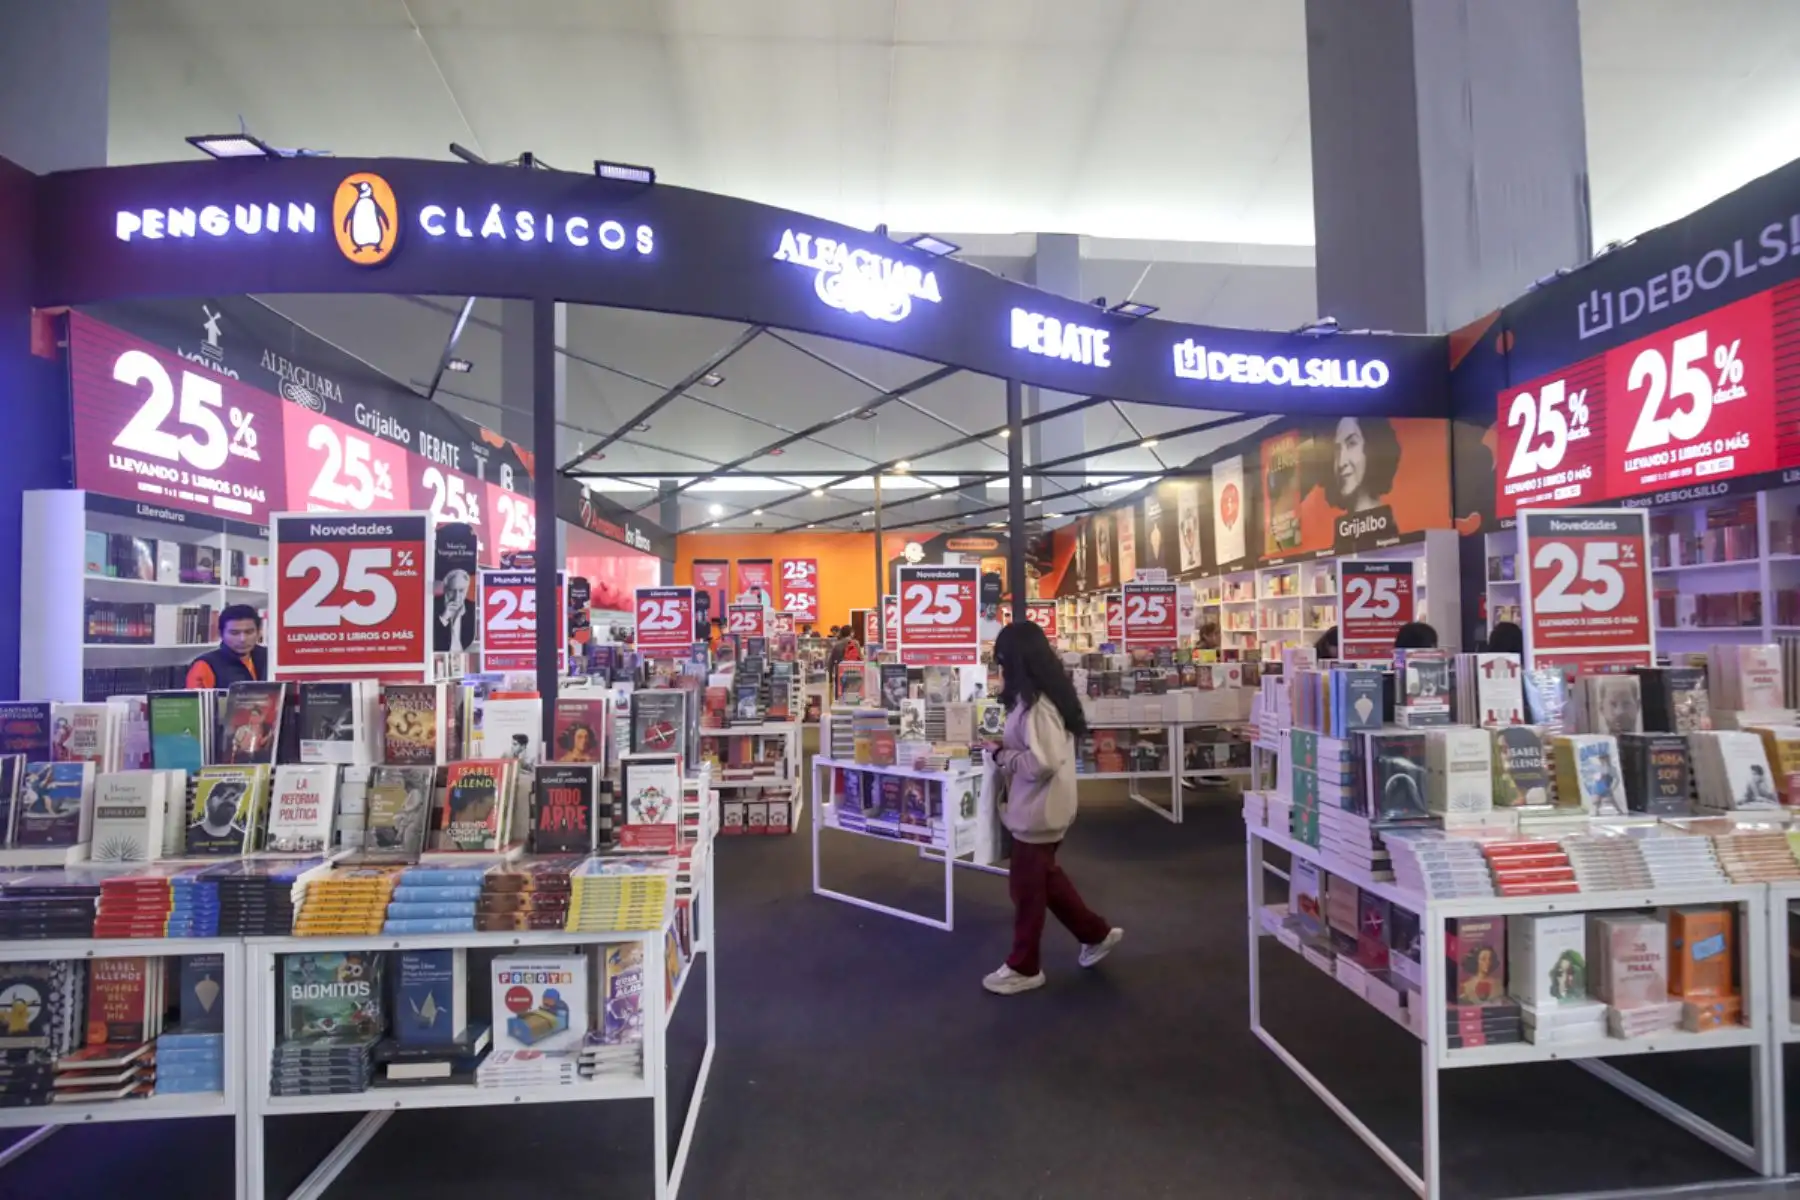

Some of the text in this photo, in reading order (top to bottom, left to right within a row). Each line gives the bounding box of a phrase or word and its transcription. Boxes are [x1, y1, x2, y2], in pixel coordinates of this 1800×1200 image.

[115, 202, 655, 254] PENGUIN CLÁSICOS
[773, 228, 942, 303] ALFAGUARA
[1009, 307, 1112, 368] DEBATE
[260, 348, 345, 404] ALFAGUARA
[1208, 349, 1390, 389] DEBOLSILLO
[1625, 330, 1744, 453] 25%
[112, 350, 257, 470] 25%
[355, 403, 411, 444] Grijalbo
[1506, 379, 1589, 479] 25%
[419, 430, 460, 470] DEBATE
[1624, 450, 1669, 472] LLEVANDO
[1678, 441, 1712, 461] LIBROS
[1714, 440, 1723, 454] O
[1725, 431, 1750, 451] MÁS
[109, 454, 179, 483] LLEVANDO
[192, 473, 230, 495] LIBROS
[232, 484, 241, 497] O
[243, 484, 266, 503] MÁS
[308, 423, 391, 510] 25%
[1574, 464, 1592, 480] MÁS
[1620, 482, 1728, 508] Libros DEBOLSILLO
[137, 503, 186, 522] Literatura
[1550, 519, 1617, 531] Novedades
[310, 523, 393, 538] Novedades
[1338, 515, 1387, 538] Grijalbo
[283, 547, 414, 628] 25%
[916, 571, 960, 579] Novedades
[1534, 542, 1639, 613] 25%
[904, 584, 971, 625] 25%
[1127, 595, 1173, 625] 25%
[1345, 577, 1408, 619] 25%
[639, 599, 688, 631] 25%
[287, 629, 414, 642] LLEVANDO 3 LIBROS O MÁS
[296, 778, 308, 790] LA
[458, 767, 494, 776] ISABEL
[280, 793, 320, 804] REFORMA
[548, 788, 581, 805] TODO
[1660, 784, 1678, 795] YO
[279, 806, 318, 821] POLÍTICA
[540, 805, 588, 831] ARDE
[95, 972, 141, 981] ALLENDE
[100, 961, 135, 972] ISABEL
[96, 984, 140, 992] MUJERES
[107, 993, 125, 1001] DEL
[291, 981, 370, 1000] BIOMITOS
